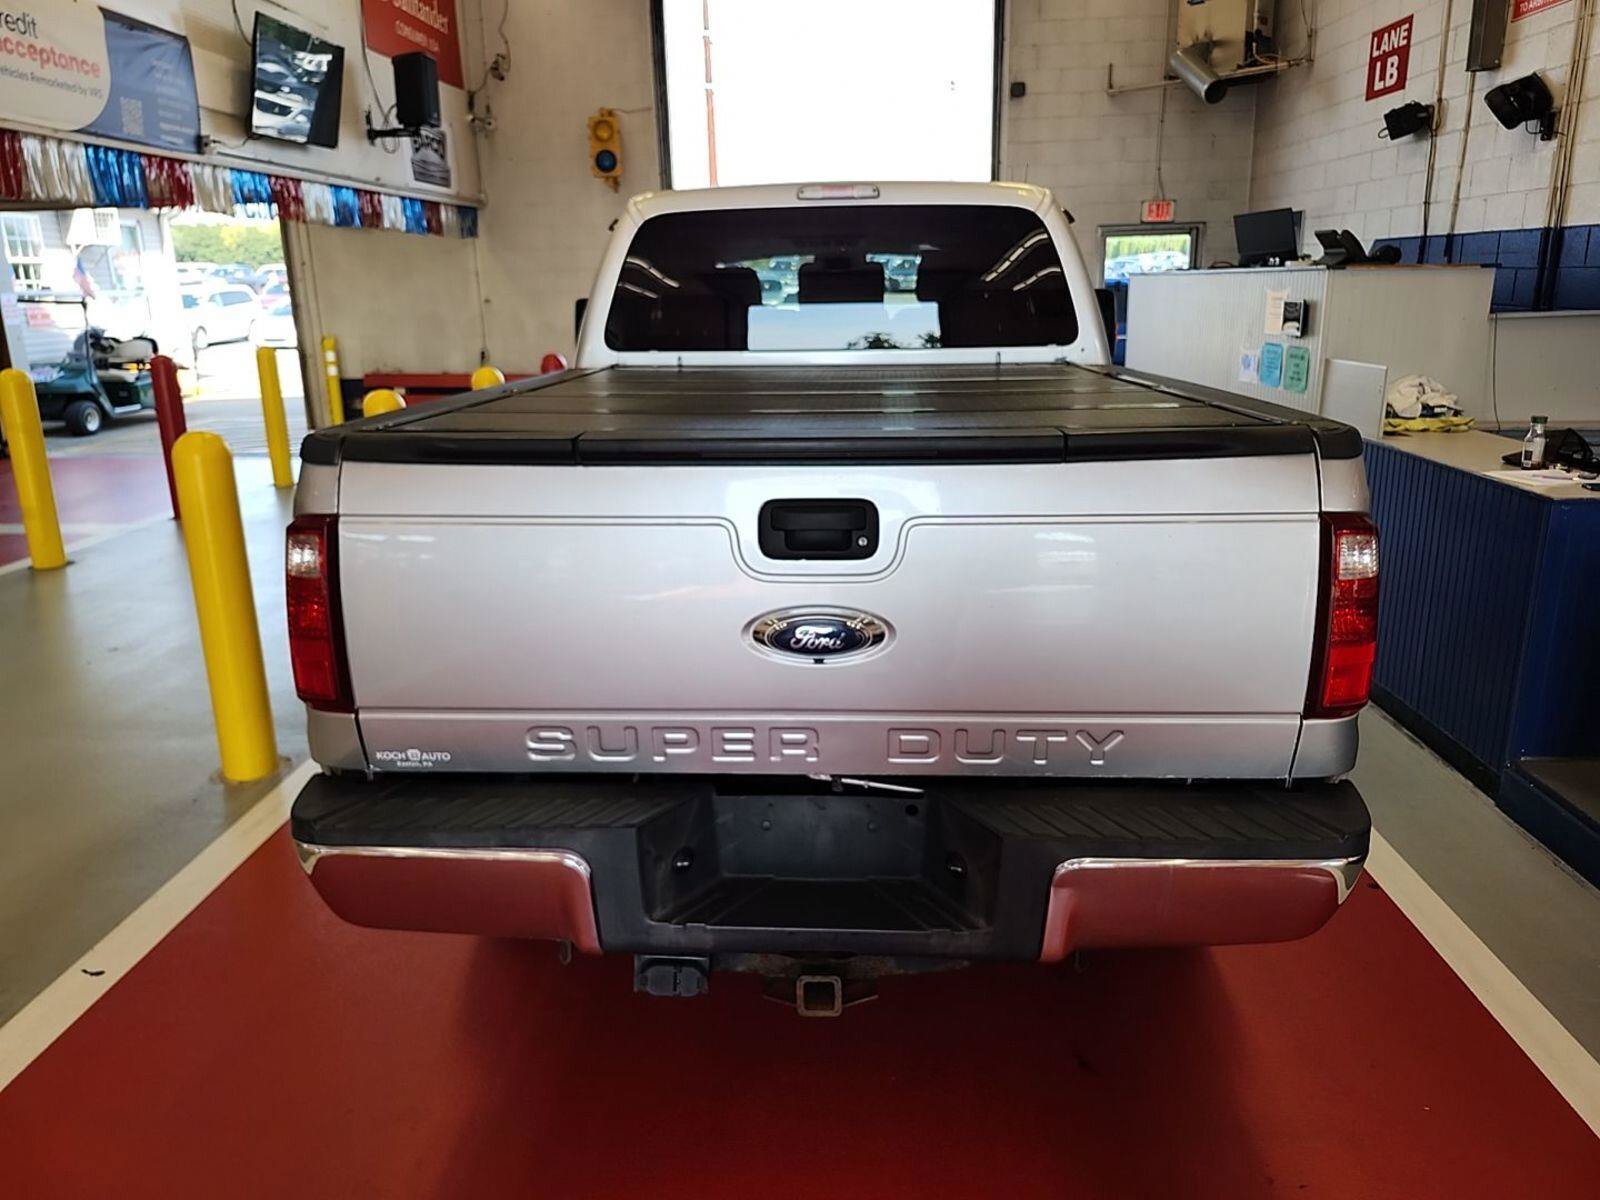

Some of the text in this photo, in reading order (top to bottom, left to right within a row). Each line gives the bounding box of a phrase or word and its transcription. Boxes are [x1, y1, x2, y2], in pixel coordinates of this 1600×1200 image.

[1372, 24, 1409, 58] LANE
[1373, 55, 1399, 92] LB
[1147, 201, 1172, 219] EXIT
[790, 625, 846, 649] Ford
[376, 751, 451, 761] KOCH AUTO
[525, 725, 1125, 765] SUPER DUTY
